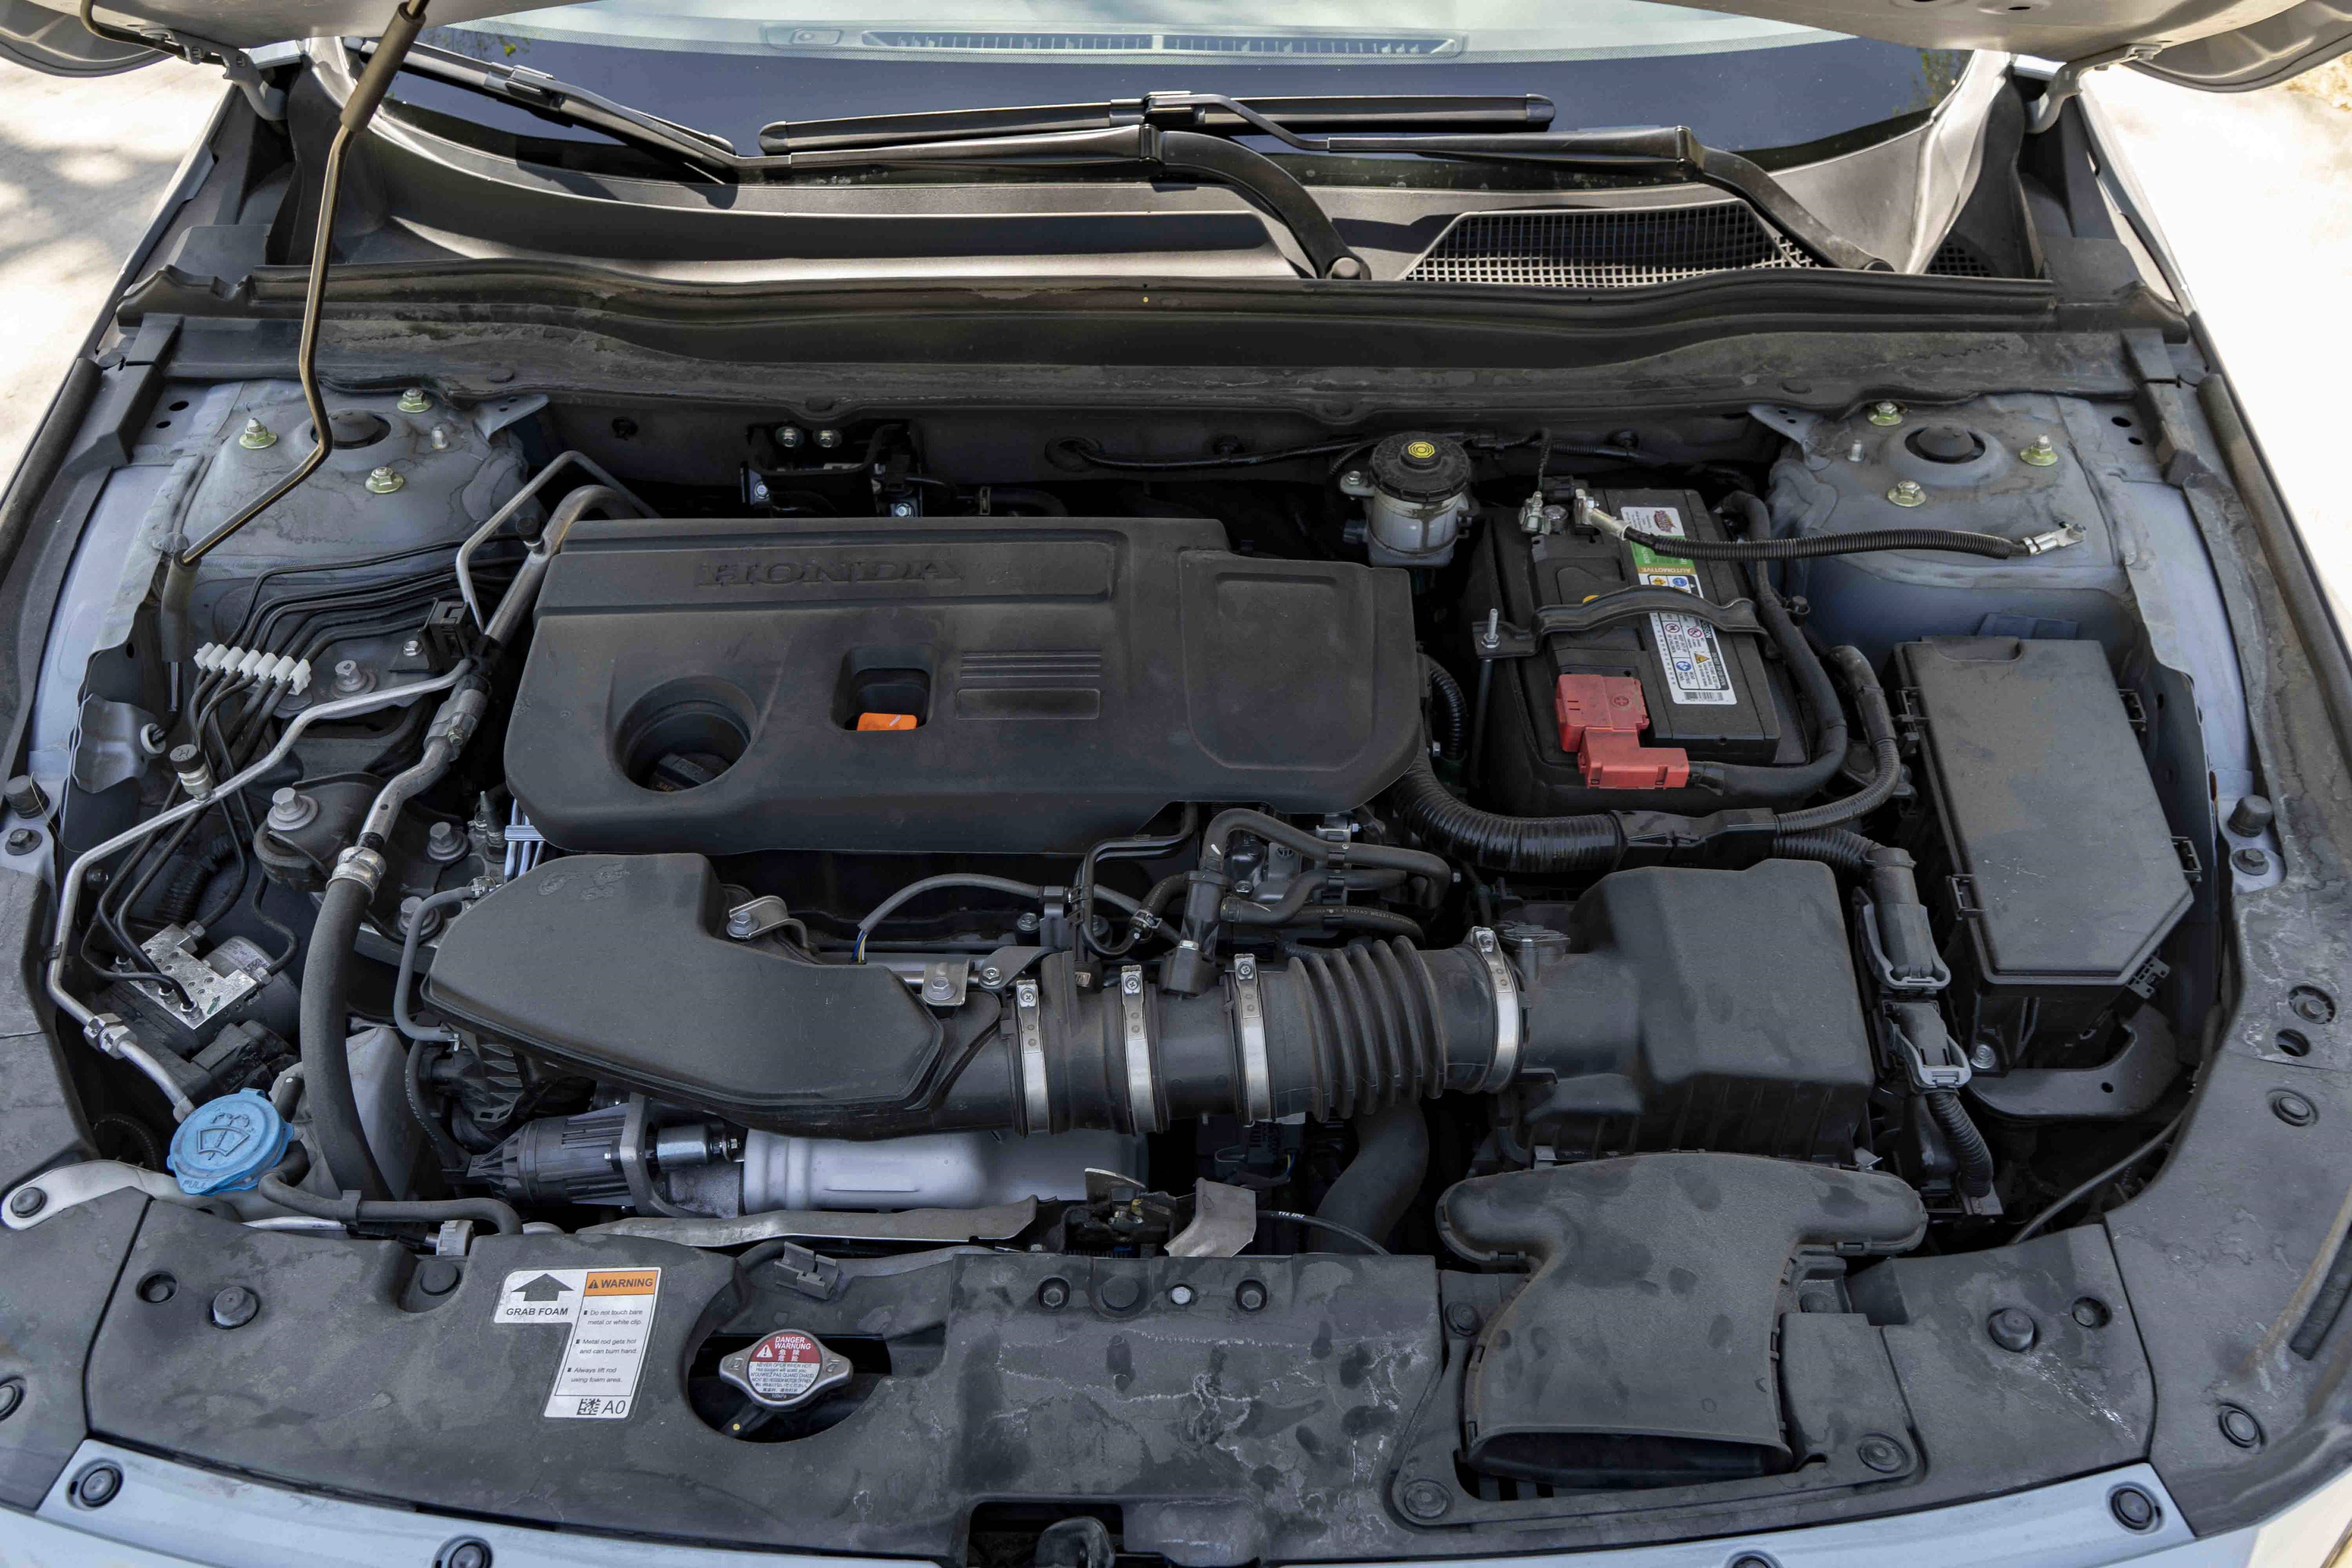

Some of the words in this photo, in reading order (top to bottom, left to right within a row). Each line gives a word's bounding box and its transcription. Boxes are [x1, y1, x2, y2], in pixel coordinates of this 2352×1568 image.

[695, 560, 964, 587] HONDA
[182, 1179, 206, 1190] PULL
[601, 1278, 653, 1288] WARNING
